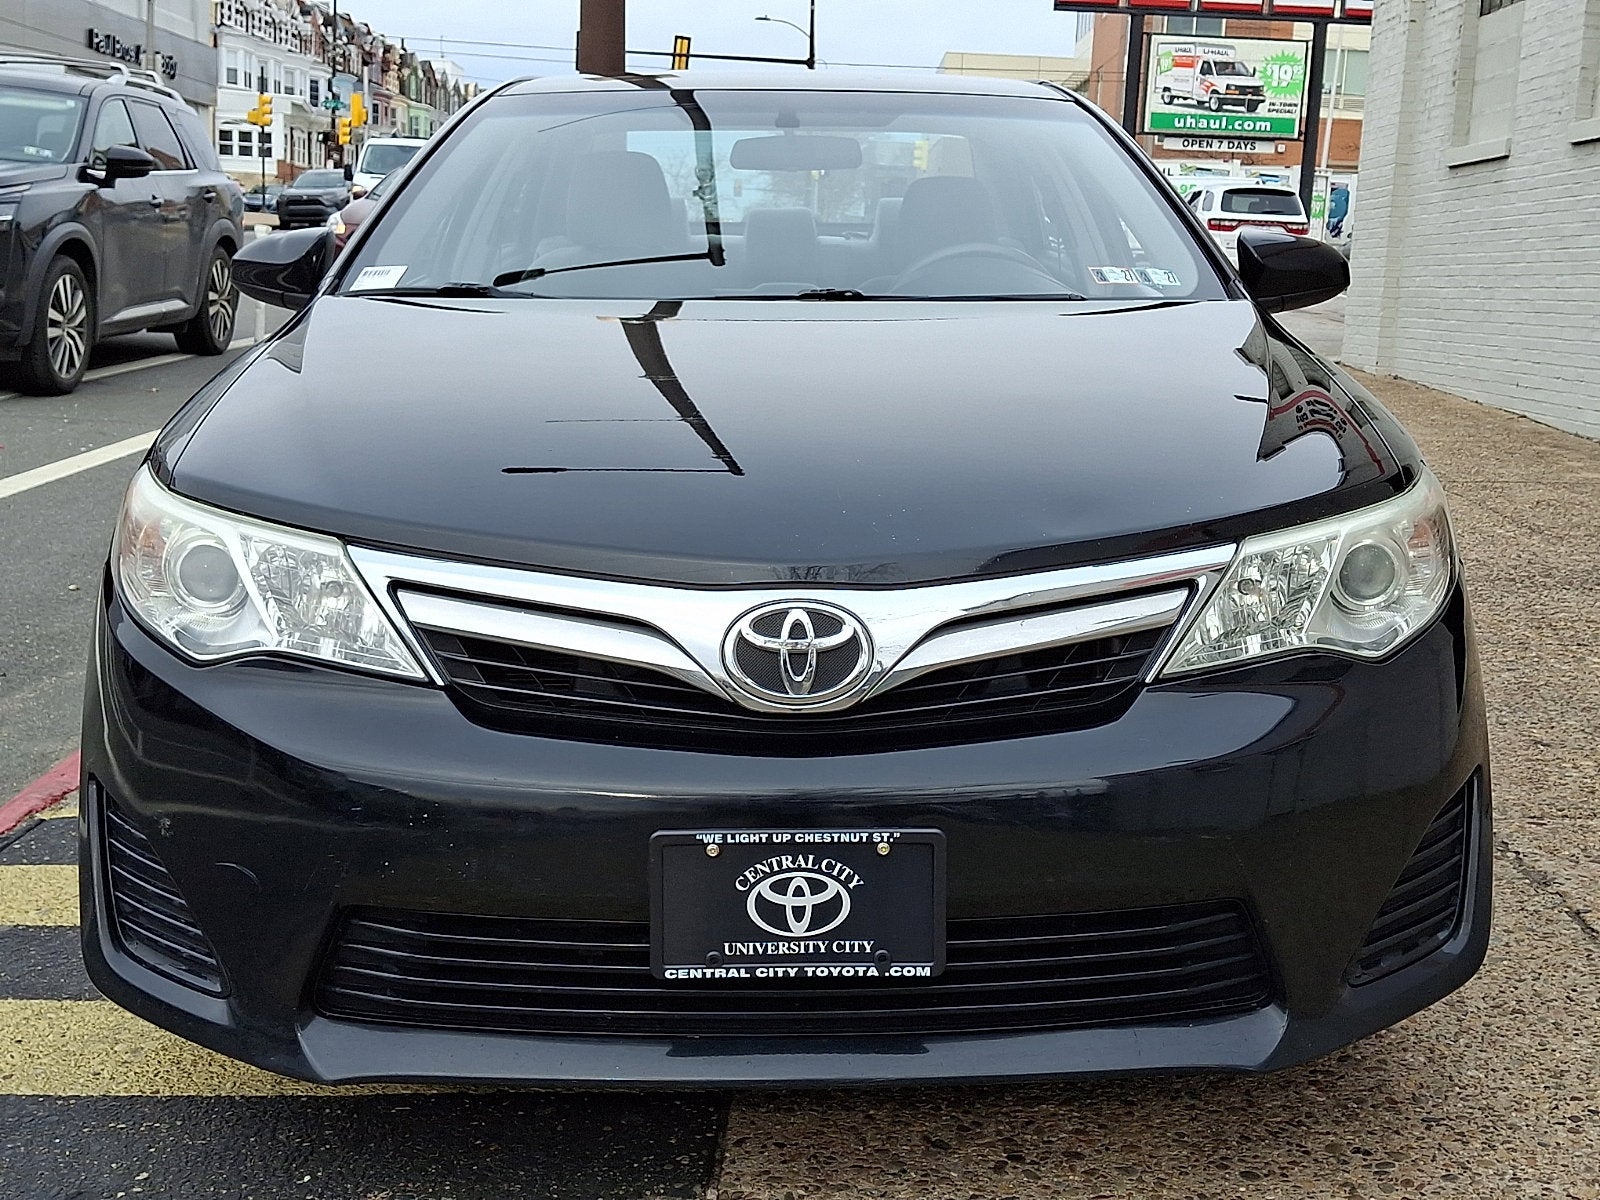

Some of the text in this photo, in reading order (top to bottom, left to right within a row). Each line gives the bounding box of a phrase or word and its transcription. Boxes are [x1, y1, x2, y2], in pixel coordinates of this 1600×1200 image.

[1174, 115, 1271, 132] uhaul.com
[1182, 139, 1257, 151] OPEN 7 DAYS
[727, 833, 768, 844] LIGHT
[772, 833, 791, 843] UP
[792, 832, 868, 843] CHESTNUT
[734, 854, 865, 892] CENTRAL CITY
[724, 940, 875, 956] UNIVERSITY CITY
[664, 966, 932, 979] CENTRAL CITY TOYOTA .COM
